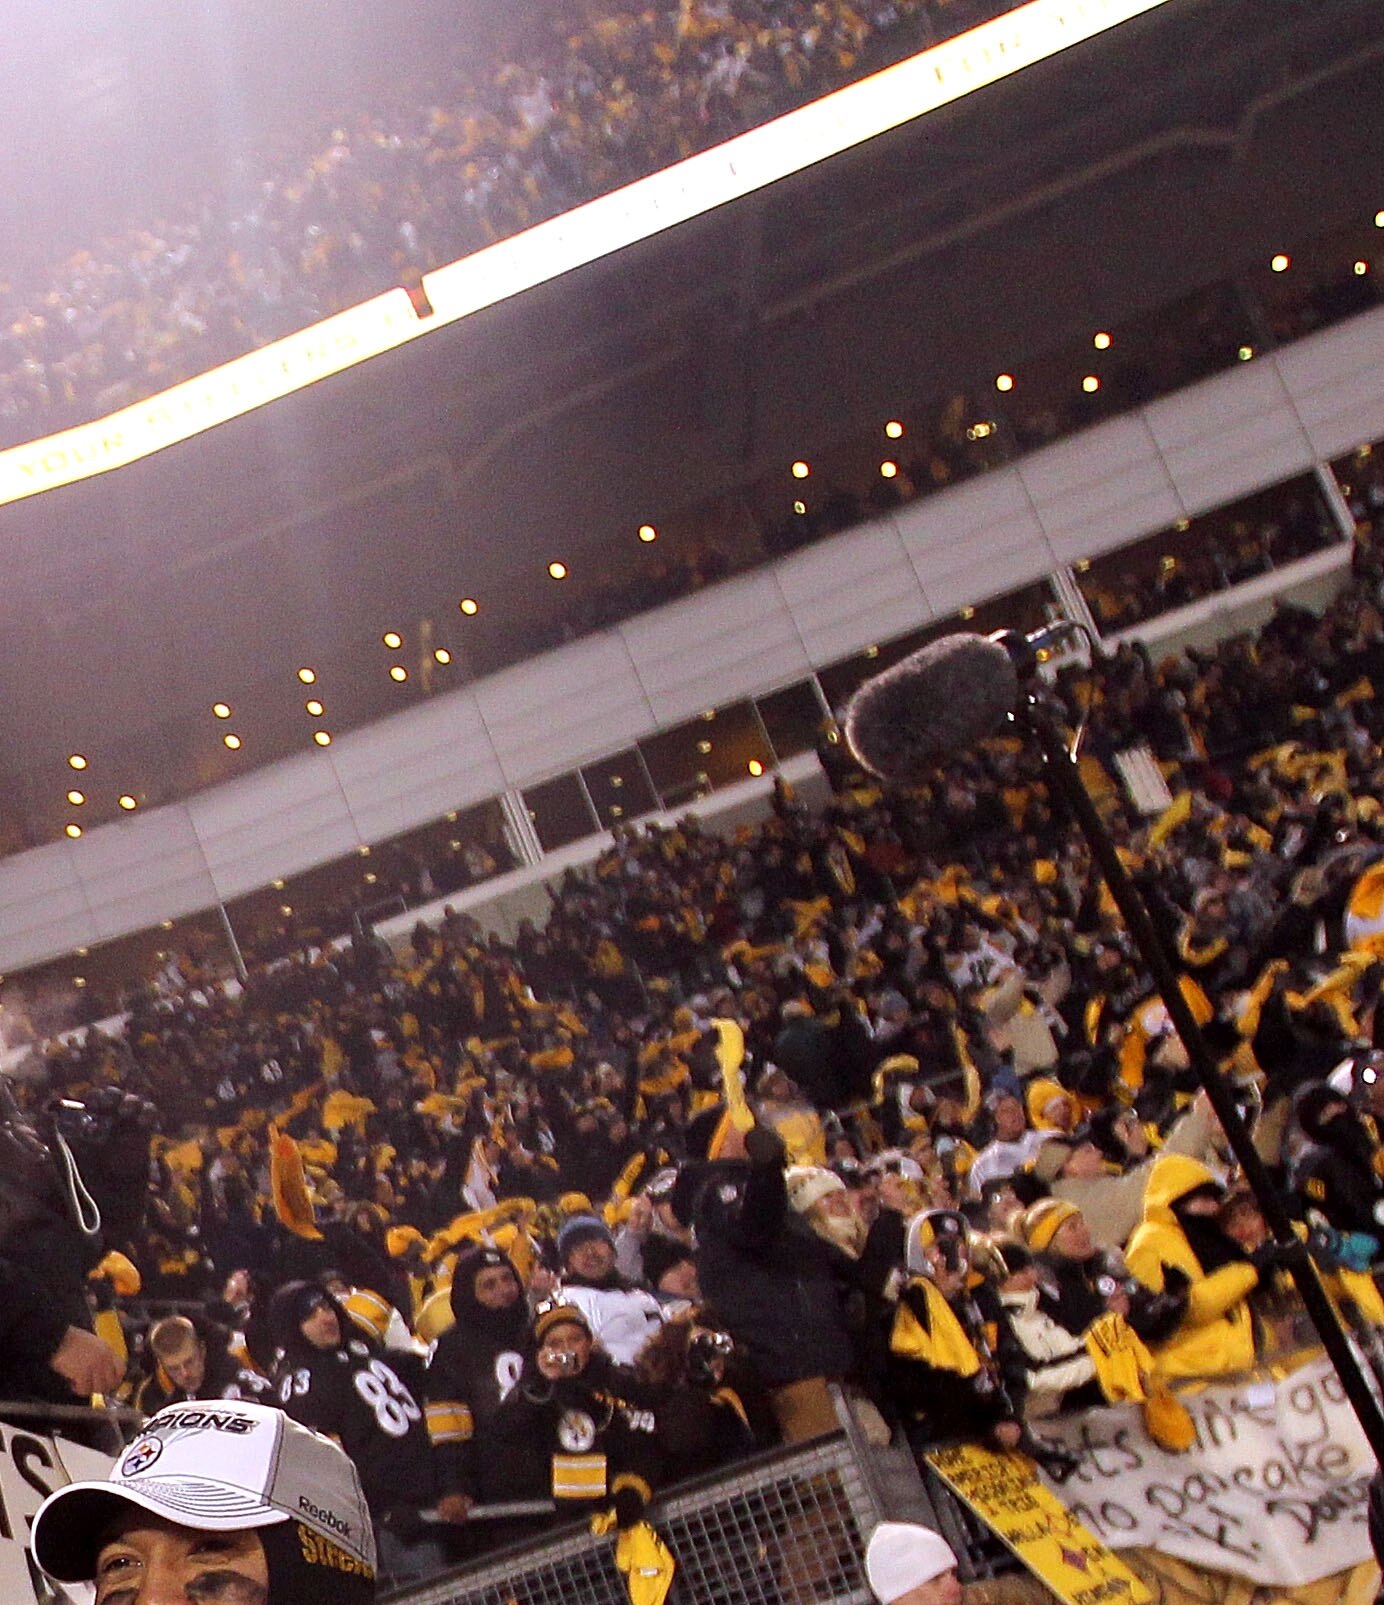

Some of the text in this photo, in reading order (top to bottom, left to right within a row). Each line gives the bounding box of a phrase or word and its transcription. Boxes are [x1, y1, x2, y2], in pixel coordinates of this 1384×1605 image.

[17, 430, 125, 478] YOUR
[355, 1359, 422, 1437] 83
[299, 1495, 351, 1538] Reebok
